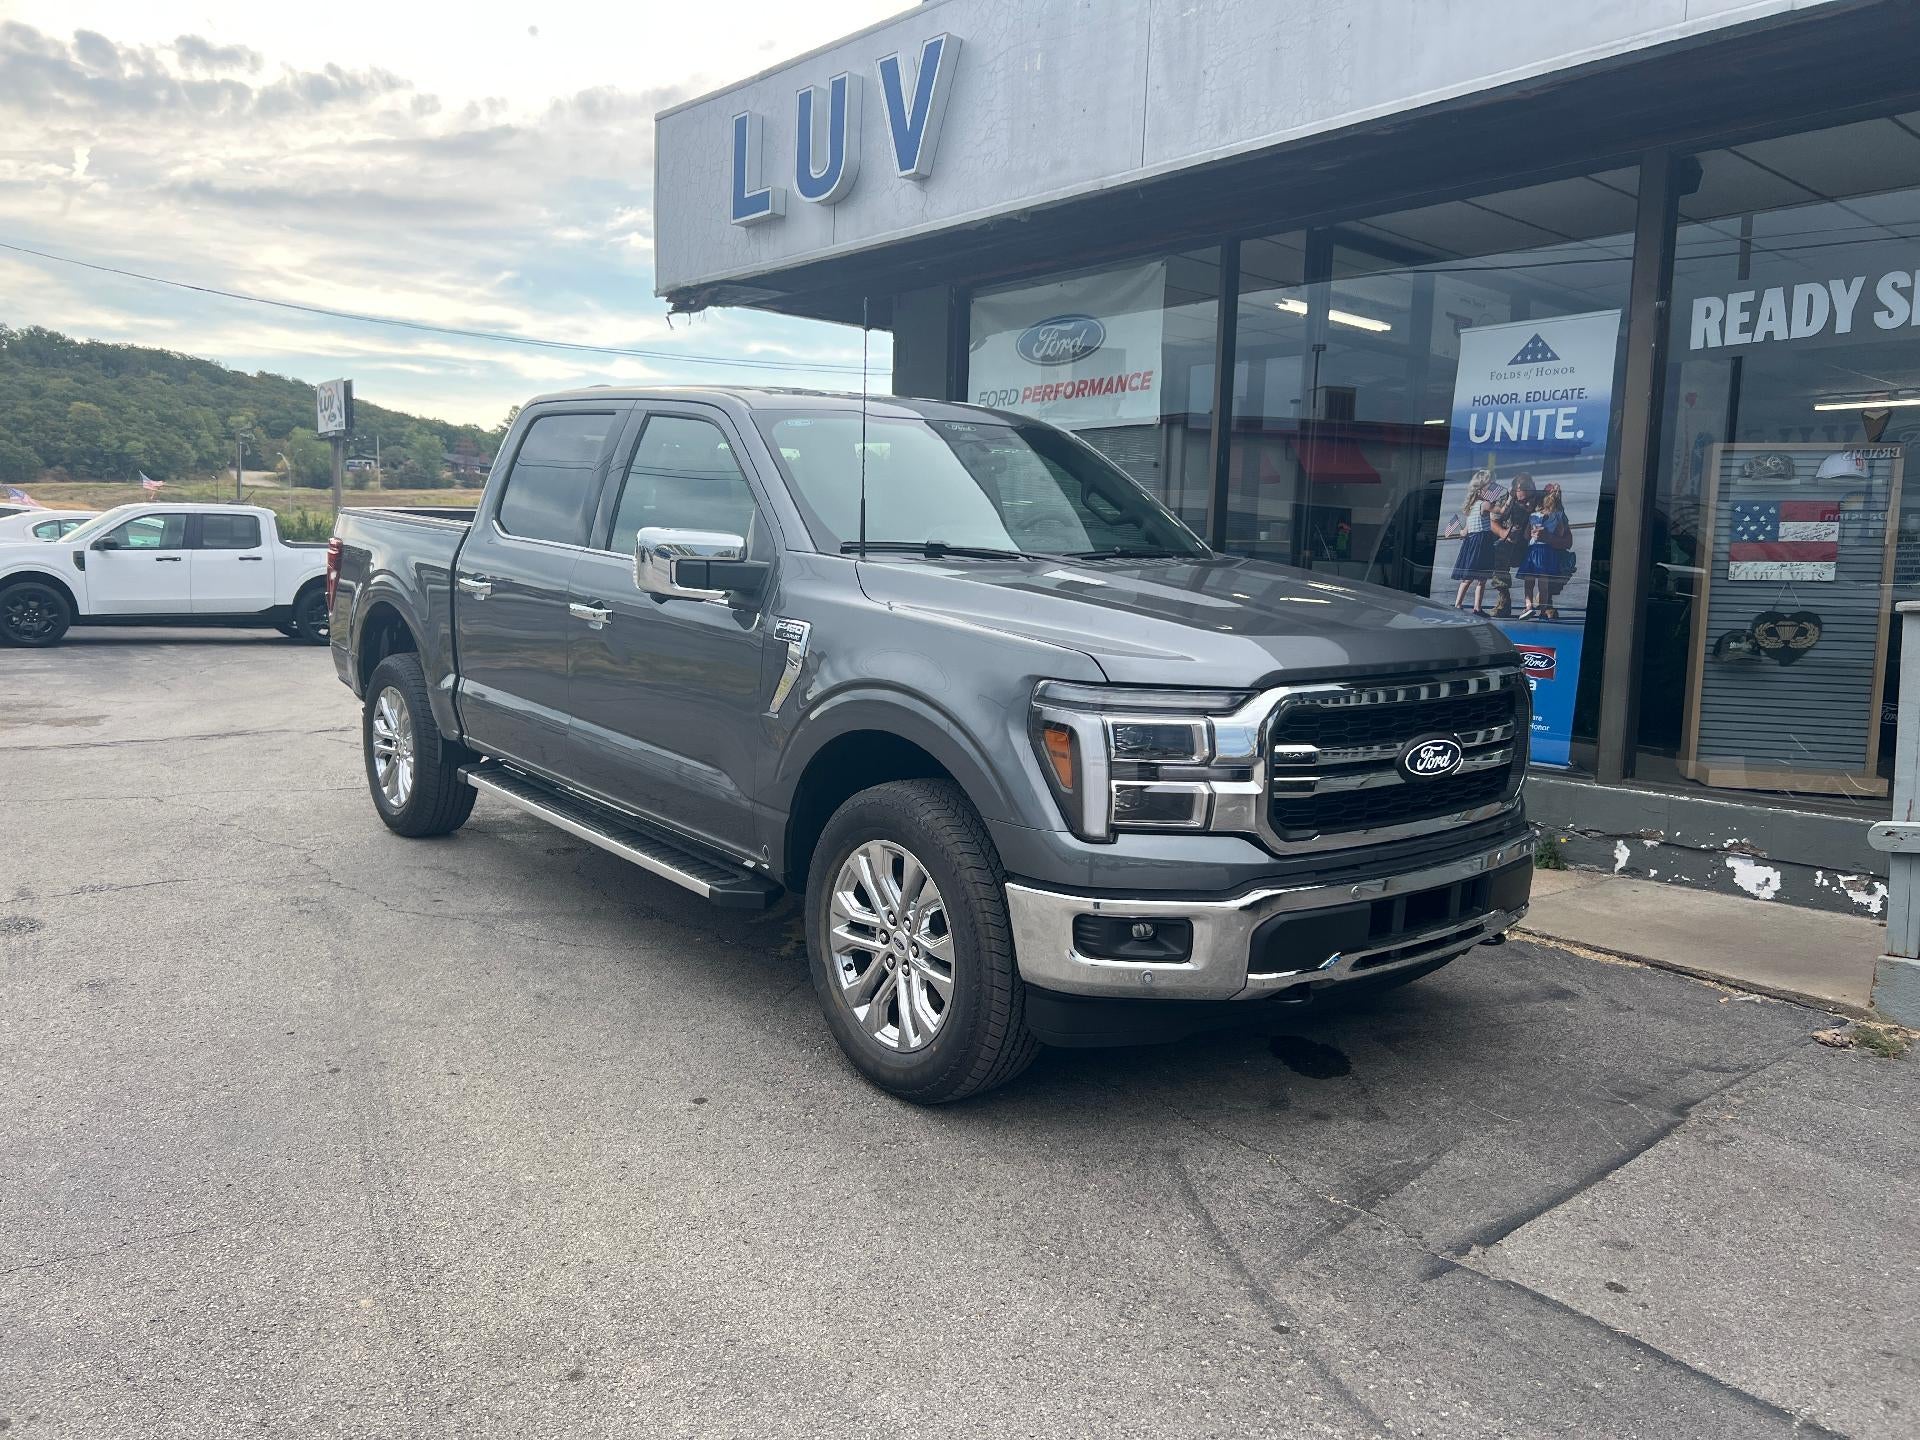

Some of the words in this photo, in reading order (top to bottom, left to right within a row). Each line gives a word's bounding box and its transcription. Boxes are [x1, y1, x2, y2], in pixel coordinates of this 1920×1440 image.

[731, 32, 963, 227] LUV
[1689, 275, 1867, 350] READY
[1033, 324, 1088, 358] Ford
[978, 388, 1019, 408] FORD
[1021, 370, 1153, 405] PERFORMANCE
[1523, 368, 1533, 380] of
[1472, 392, 1521, 407] HONOR.
[1525, 387, 1588, 403] EDUCATE.
[1469, 406, 1584, 444] UNITE.
[1523, 654, 1548, 668] Ford
[1416, 745, 1452, 771] Ford
